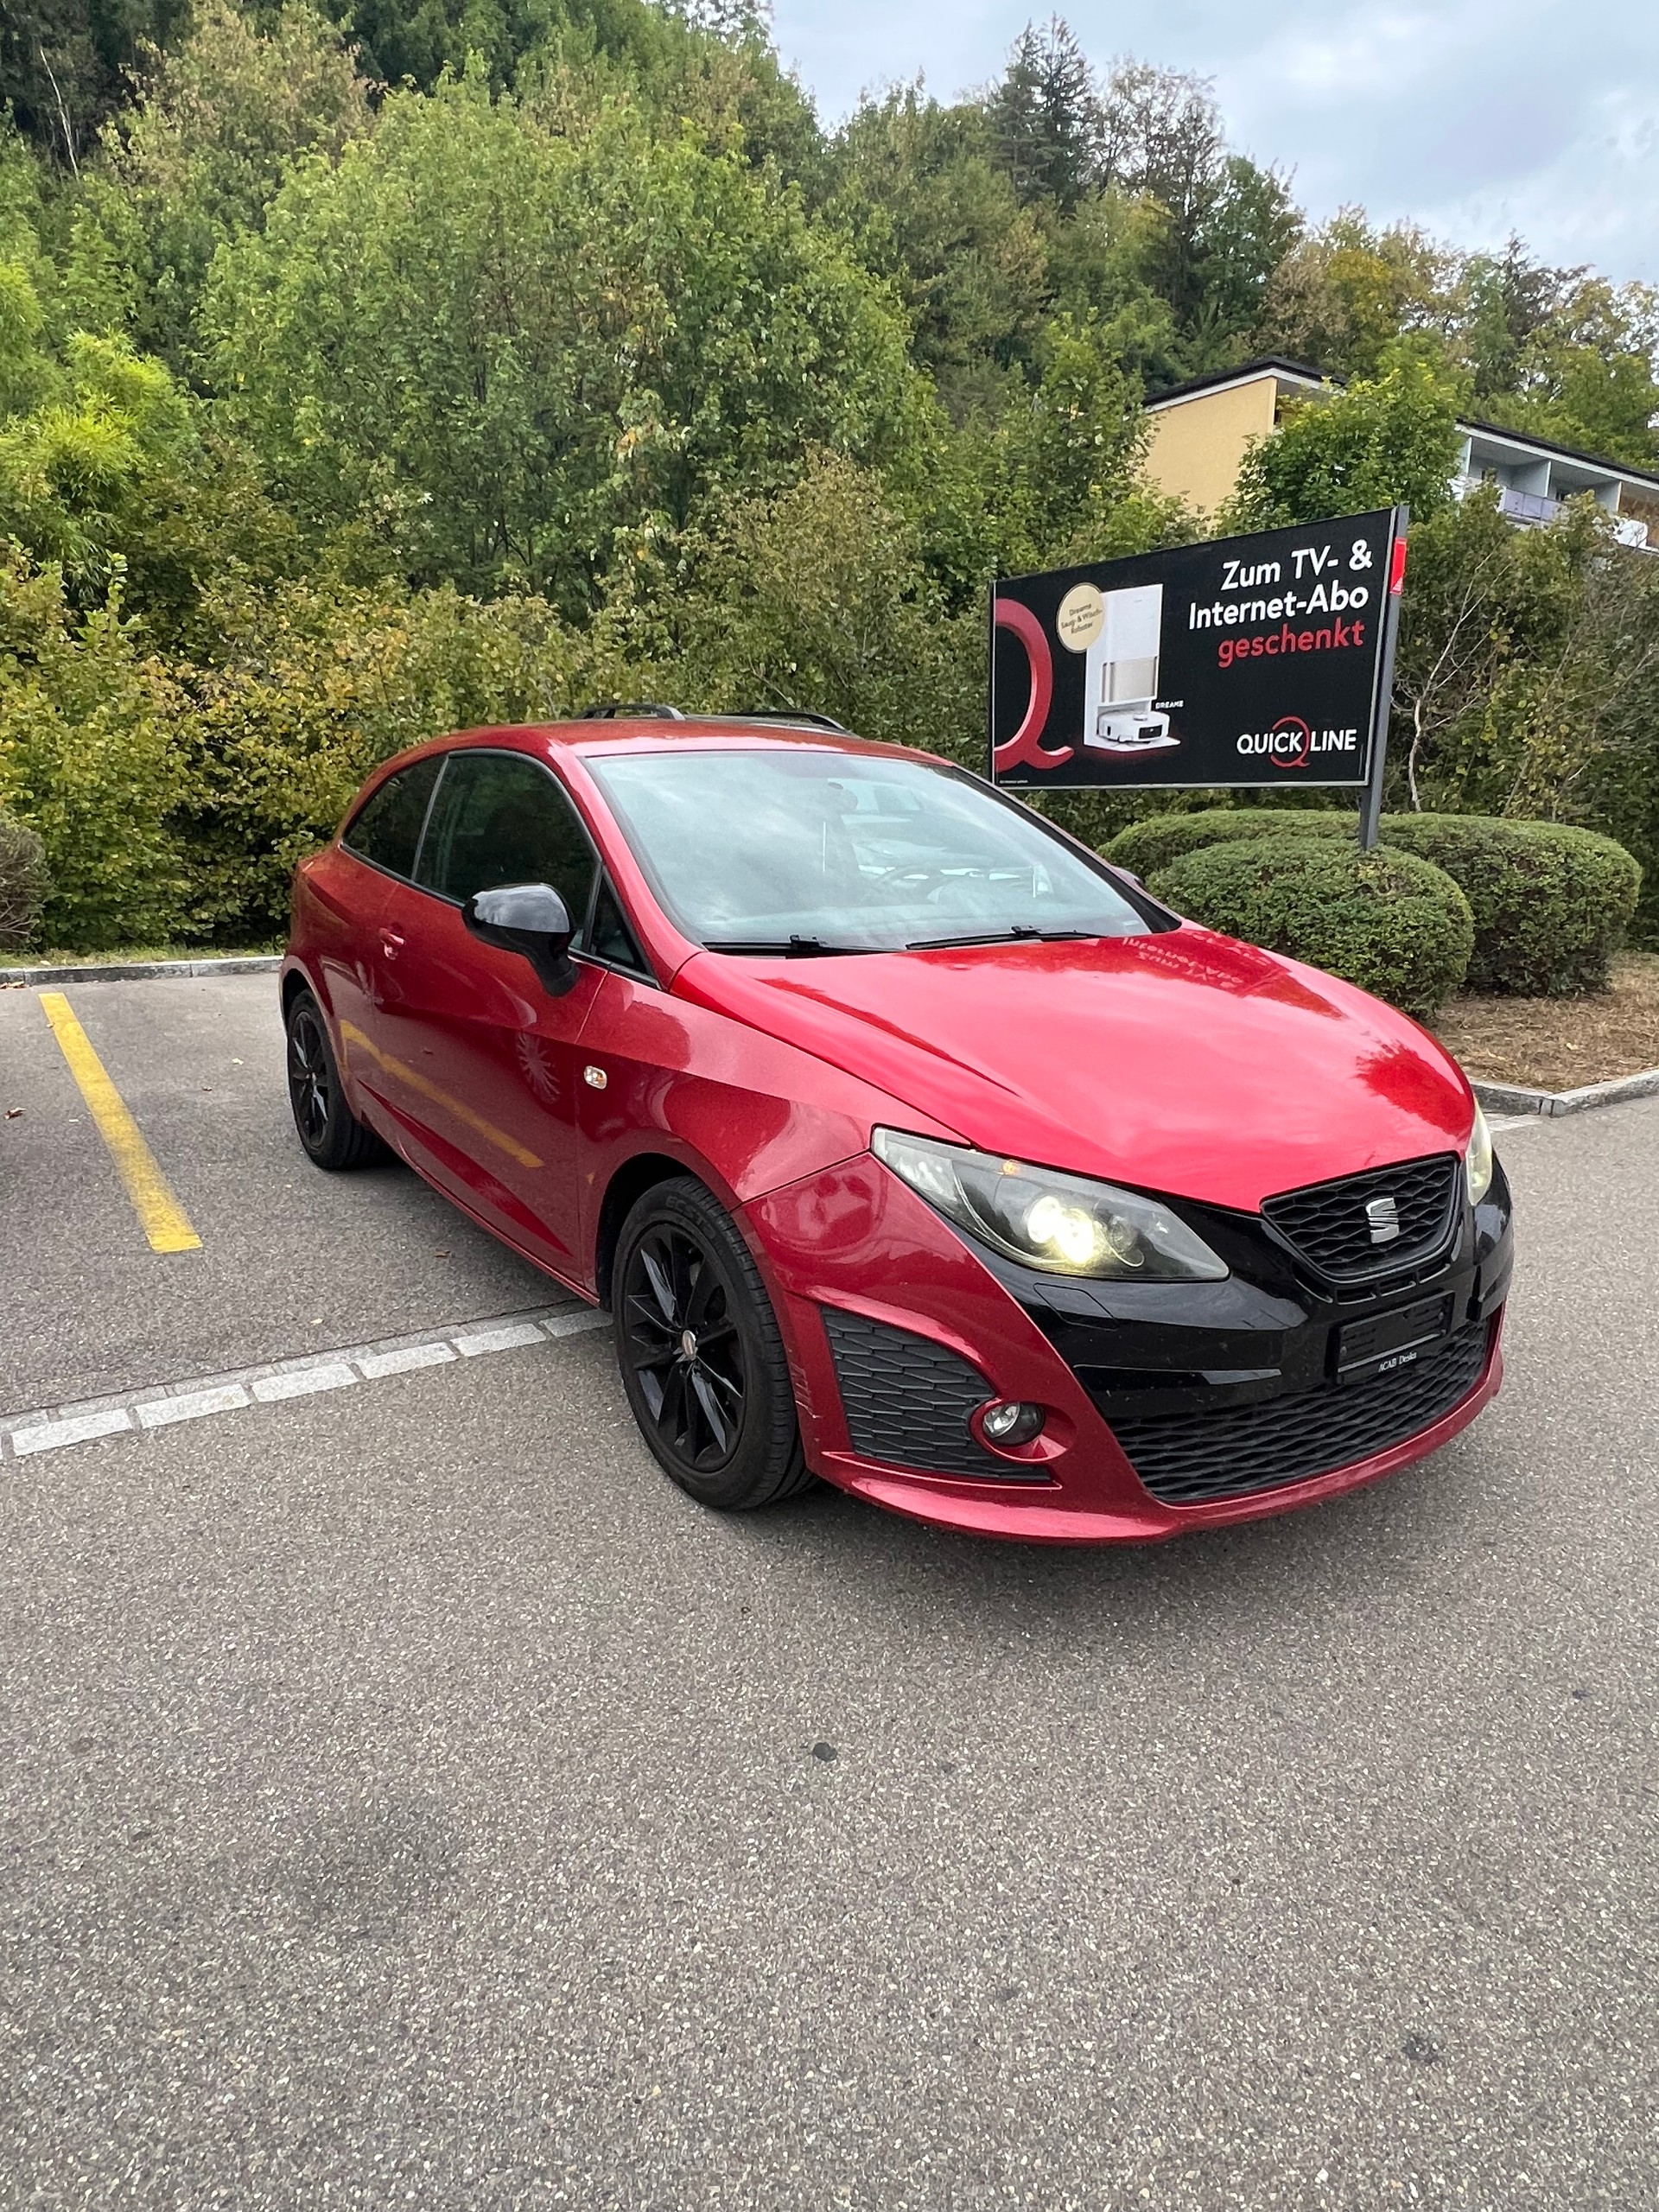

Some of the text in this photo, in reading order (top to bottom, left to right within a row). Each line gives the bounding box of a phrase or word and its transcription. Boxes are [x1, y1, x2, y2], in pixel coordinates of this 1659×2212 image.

[1220, 538, 1374, 591] Zum TV- &
[1189, 579, 1370, 631] Internet-Abo
[1217, 616, 1365, 669] geschenkt
